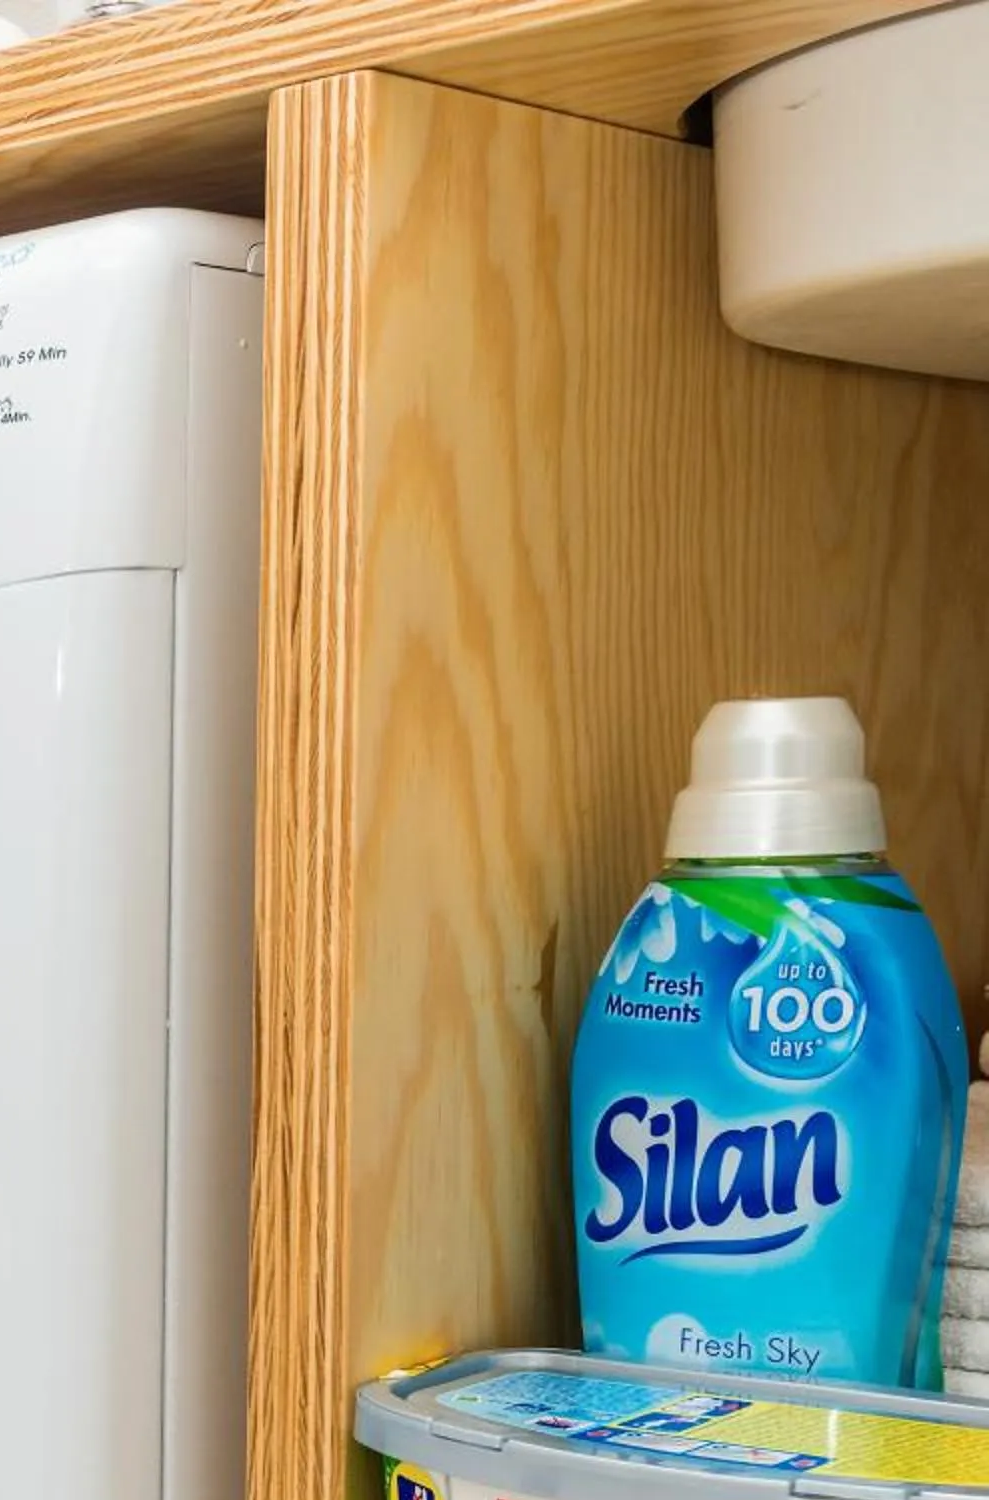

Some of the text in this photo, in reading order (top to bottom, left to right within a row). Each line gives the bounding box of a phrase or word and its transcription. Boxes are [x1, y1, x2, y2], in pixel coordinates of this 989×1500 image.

[17, 351, 36, 365] 59
[39, 347, 67, 362] Min
[643, 970, 705, 997] Fresh
[777, 961, 827, 982] up to
[604, 991, 702, 1023] Moments
[741, 985, 854, 1033] 100
[584, 1095, 842, 1243] Silan
[678, 1326, 821, 1374] Fresh Sky
